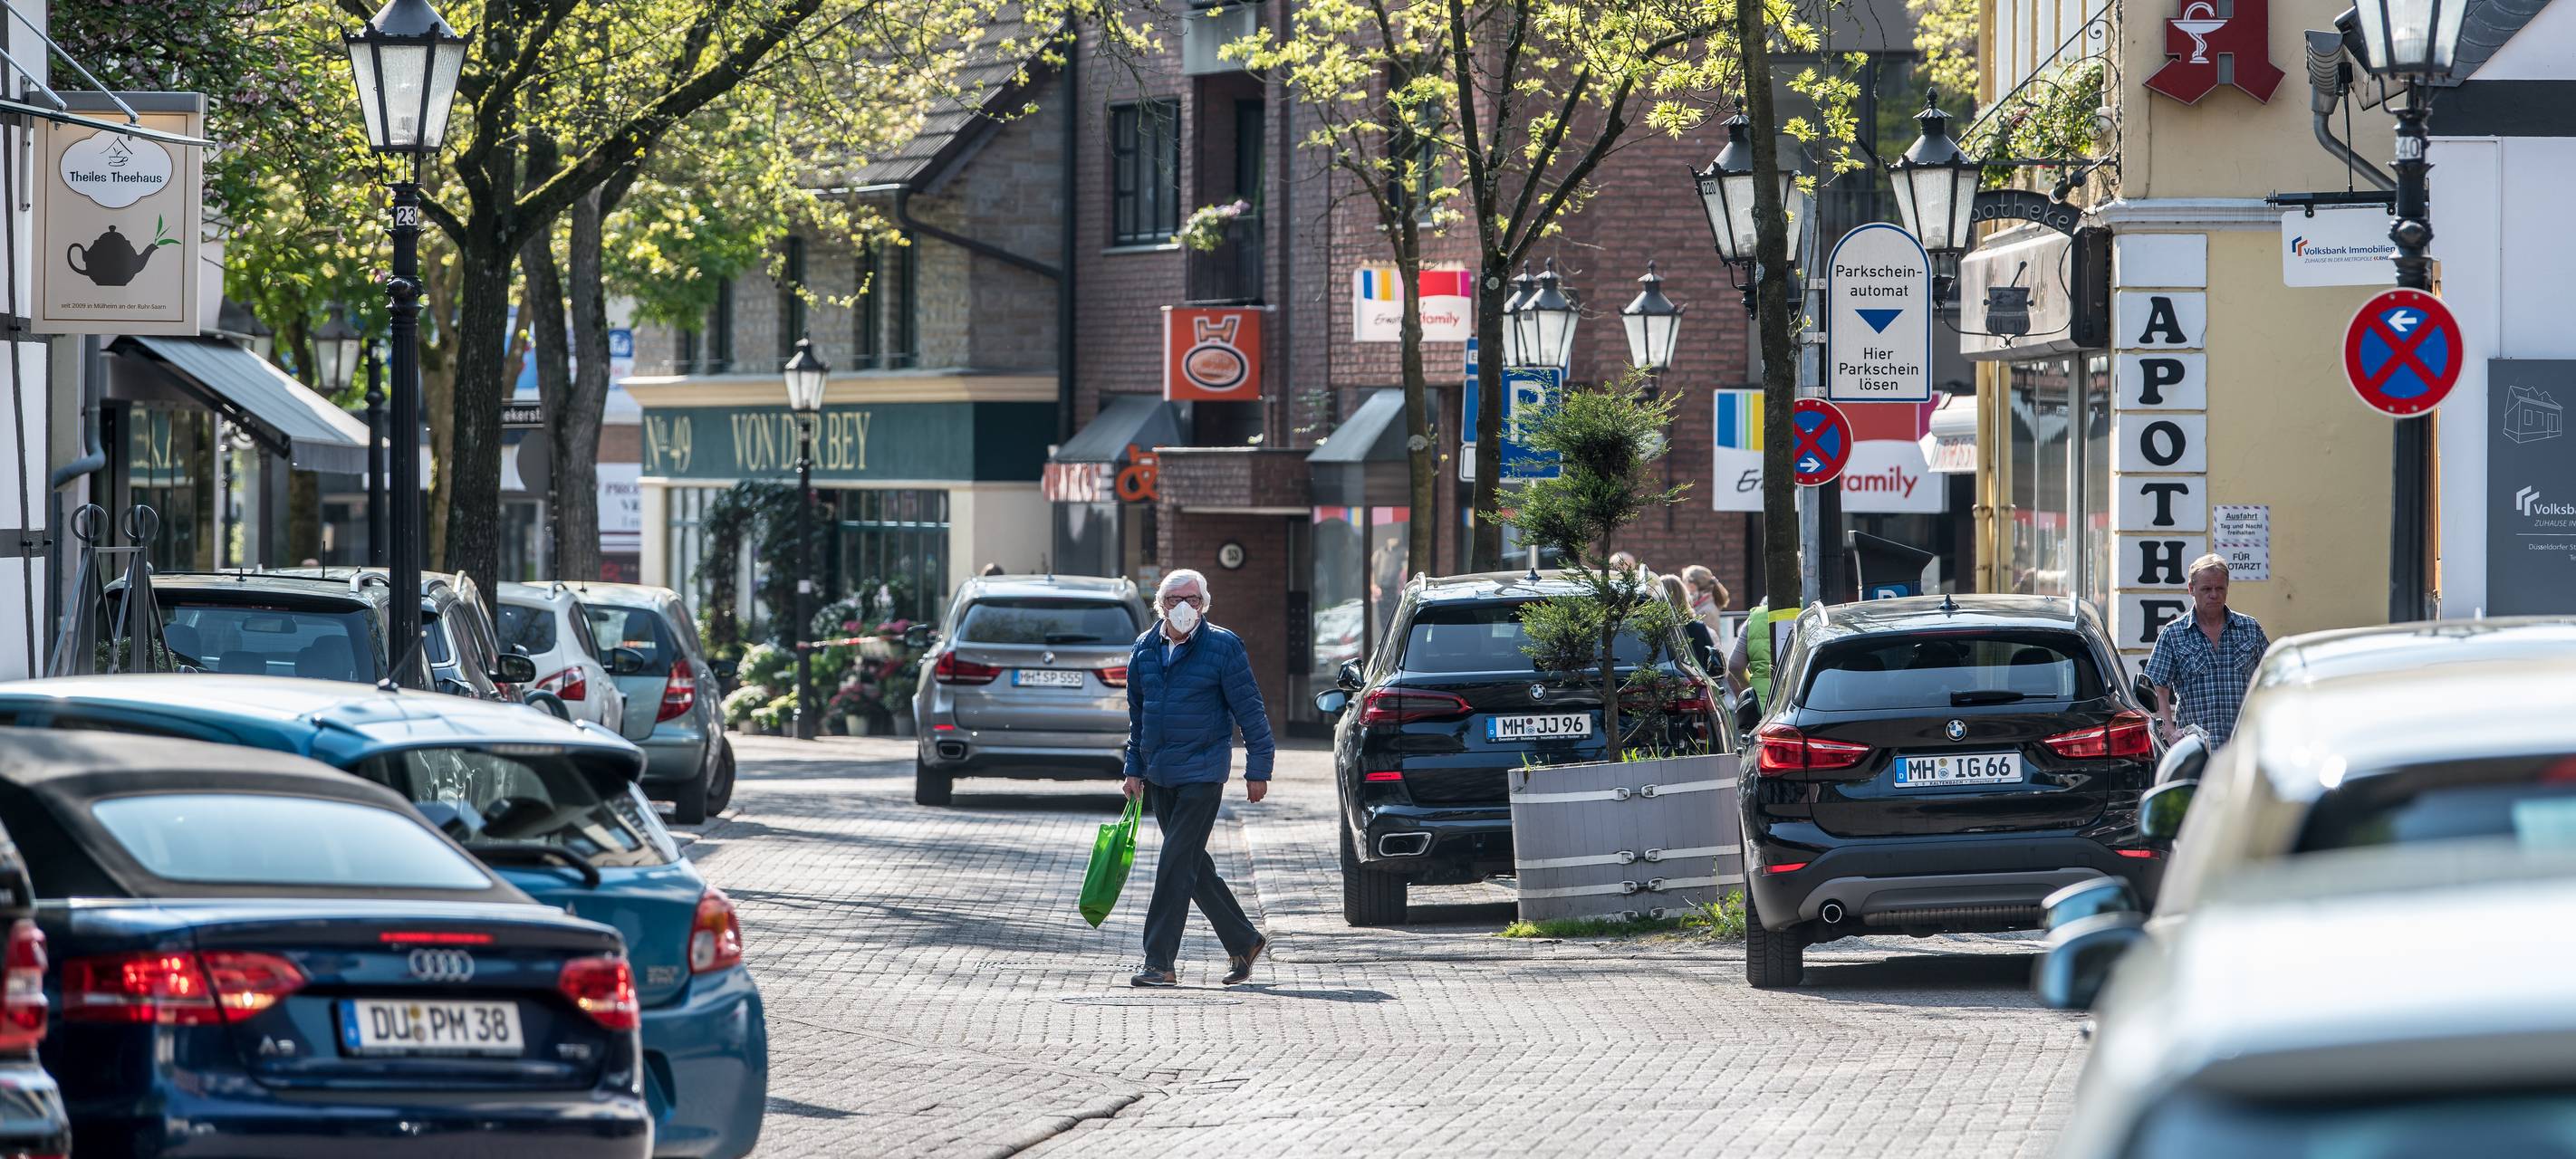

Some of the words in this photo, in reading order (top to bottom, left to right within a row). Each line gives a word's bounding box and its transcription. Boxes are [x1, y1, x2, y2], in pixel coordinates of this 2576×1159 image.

[70, 171, 107, 182] Theiles
[111, 171, 162, 183] Theehaus
[1703, 181, 1716, 196] 220
[2304, 245, 2348, 255] Volksbank
[2349, 244, 2396, 254] Immobilien
[1836, 264, 1923, 278] Parkschein-
[1850, 284, 1908, 297] automat
[1863, 347, 1894, 359] Hier
[1840, 362, 1919, 376] Parkschein
[1860, 378, 1898, 390] lösen
[731, 413, 778, 472] VON
[780, 413, 823, 471] DR
[827, 411, 871, 471] BEY
[2225, 512, 2258, 521] Ausfahrt
[2233, 551, 2251, 560] FÜR
[2227, 562, 2262, 570] OTARZT
[1043, 672, 1058, 683] SP
[1060, 672, 1081, 684] 555
[1503, 718, 1525, 735] MH
[1537, 717, 1559, 733] JJ
[1562, 716, 1583, 733] 96
[1908, 759, 1936, 780] MH
[1955, 758, 1982, 778] IG
[1985, 756, 2011, 777] 66
[370, 1006, 410, 1040] DU
[428, 1007, 469, 1041] PM
[473, 1007, 510, 1041] 38
